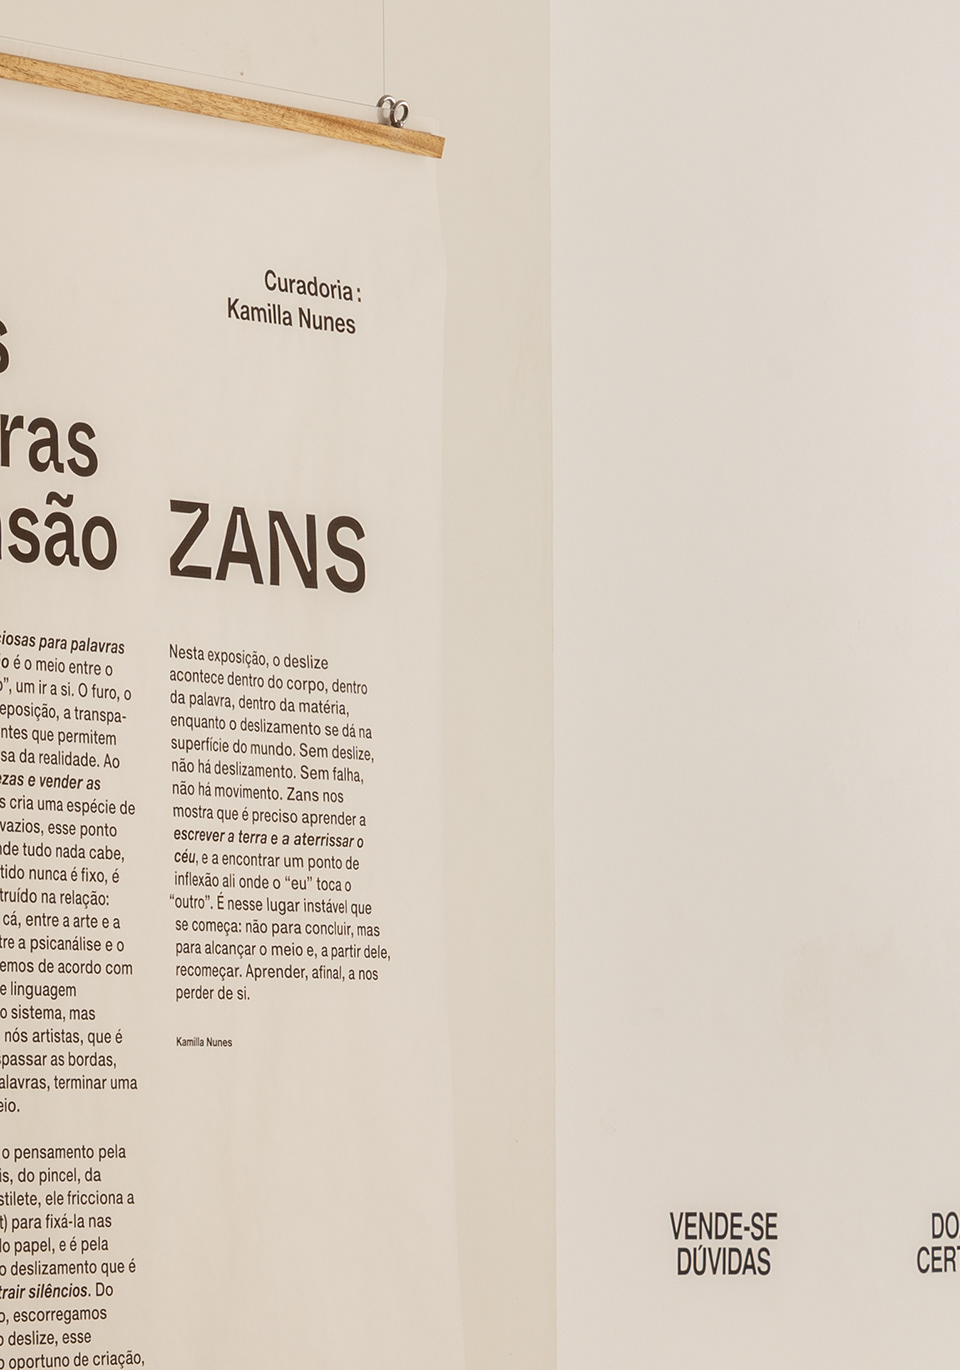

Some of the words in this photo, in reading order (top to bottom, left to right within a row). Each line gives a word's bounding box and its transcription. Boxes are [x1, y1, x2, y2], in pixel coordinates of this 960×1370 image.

[227, 296, 293, 327] Kamilla
[298, 306, 356, 335] Nunes
[0, 491, 118, 571] são
[169, 499, 366, 594] ZANS
[70, 637, 125, 655] palavras
[169, 643, 205, 661] Nesta
[207, 649, 269, 669] exposição,
[272, 655, 281, 667] o
[283, 653, 329, 670] deslize
[68, 660, 102, 676] entre
[169, 669, 225, 685] acontece
[227, 671, 265, 688] dentro
[267, 674, 284, 690] do
[286, 678, 329, 695] corpo,
[331, 678, 368, 695] dentro
[169, 689, 186, 705] da
[189, 691, 235, 711] palavra,
[238, 694, 276, 711] dentro
[279, 697, 296, 713] da
[298, 699, 350, 718] matéria,
[73, 706, 127, 726] transpa-
[170, 715, 226, 731] enquanto
[228, 719, 237, 731] o
[239, 717, 322, 736] deslizamento
[324, 725, 339, 737] se
[341, 723, 357, 738] dá
[358, 727, 373, 740] na
[57, 729, 117, 746] permitem
[38, 750, 100, 768] realidade.
[170, 736, 230, 754] superfície
[232, 738, 248, 754] do
[250, 741, 296, 757] mundo.
[299, 742, 329, 758] Sem
[331, 744, 374, 764] deslize,
[171, 757, 195, 773] não
[197, 758, 212, 775] há
[213, 760, 297, 779] deslizamento.
[300, 764, 330, 781] Sem
[332, 766, 364, 785] falha,
[39, 774, 84, 790] vender
[172, 780, 195, 796] não
[198, 781, 212, 797] há
[214, 783, 283, 801] movimento.
[286, 786, 320, 803] Zans
[322, 791, 344, 804] nos
[66, 798, 117, 817] espécie
[172, 804, 214, 820] mostra
[216, 808, 239, 824] que
[241, 806, 249, 822] é
[251, 808, 298, 825] preciso
[301, 811, 357, 828] aprender
[359, 815, 367, 827] a
[80, 822, 118, 840] ponto
[173, 828, 226, 843] escrever
[227, 831, 235, 843] a
[238, 829, 268, 845] terra
[270, 833, 279, 845] e
[281, 834, 290, 846] a
[293, 832, 355, 848] aterrissar
[356, 837, 364, 849] o
[173, 848, 199, 866] céu,
[201, 853, 209, 865] e
[211, 853, 219, 865] a
[221, 852, 281, 868] encontrar
[283, 856, 304, 868] um
[307, 855, 343, 872] ponto
[345, 855, 360, 871] de
[28, 868, 68, 882] nunca
[174, 870, 220, 888] inflexão
[222, 873, 236, 888] ali
[238, 874, 270, 890] onde
[272, 878, 281, 890] o
[316, 877, 343, 892] toca
[344, 880, 352, 893] o
[59, 889, 110, 910] relação:
[216, 891, 225, 910] É
[227, 899, 263, 912] nesse
[266, 896, 301, 916] lugar
[303, 897, 348, 914] instável
[350, 903, 372, 918] que
[25, 912, 60, 928] entre
[175, 919, 189, 932] se
[191, 920, 242, 937] começa:
[245, 918, 268, 934] não
[271, 922, 302, 938] para
[304, 921, 354, 939] concluir,
[356, 925, 381, 937] mas
[30, 935, 102, 954] psicanálise
[175, 942, 202, 957] para
[204, 940, 257, 960] alcançar
[259, 944, 268, 956] o
[271, 942, 304, 957] meio
[306, 945, 318, 960] e,
[321, 946, 329, 958] a
[330, 943, 362, 961] partir
[363, 944, 391, 962] dele,
[57, 959, 102, 975] acordo
[175, 965, 243, 982] recomeçar.
[245, 963, 309, 982] Aprender,
[311, 964, 345, 982] afinal,
[348, 969, 356, 981] a
[358, 969, 379, 981] nos
[10, 980, 77, 1001] linguagem
[175, 984, 215, 1003] perder
[217, 985, 234, 1001] de
[236, 985, 250, 1001] si.
[10, 1004, 66, 1023] sistema,
[31, 1027, 84, 1046] artistas,
[176, 1036, 205, 1047] Kamilla
[206, 1037, 233, 1048] Nunes
[67, 1051, 117, 1070] bordas,
[53, 1074, 108, 1090] terminar
[14, 1144, 95, 1163] pensamento
[39, 1167, 81, 1186] pincel,
[66, 1189, 124, 1206] fricciona
[45, 1212, 86, 1229] fixá-la
[669, 1211, 778, 1242] VENDE-SE
[14, 1236, 56, 1257] papel,
[10, 1259, 98, 1277] deslizamento
[677, 1244, 771, 1276] DÚVIDAS
[28, 1282, 92, 1299] silêncios.
[12, 1308, 108, 1325] escorregamos
[7, 1330, 59, 1348] deslize,
[92, 1349, 145, 1370] criação,
